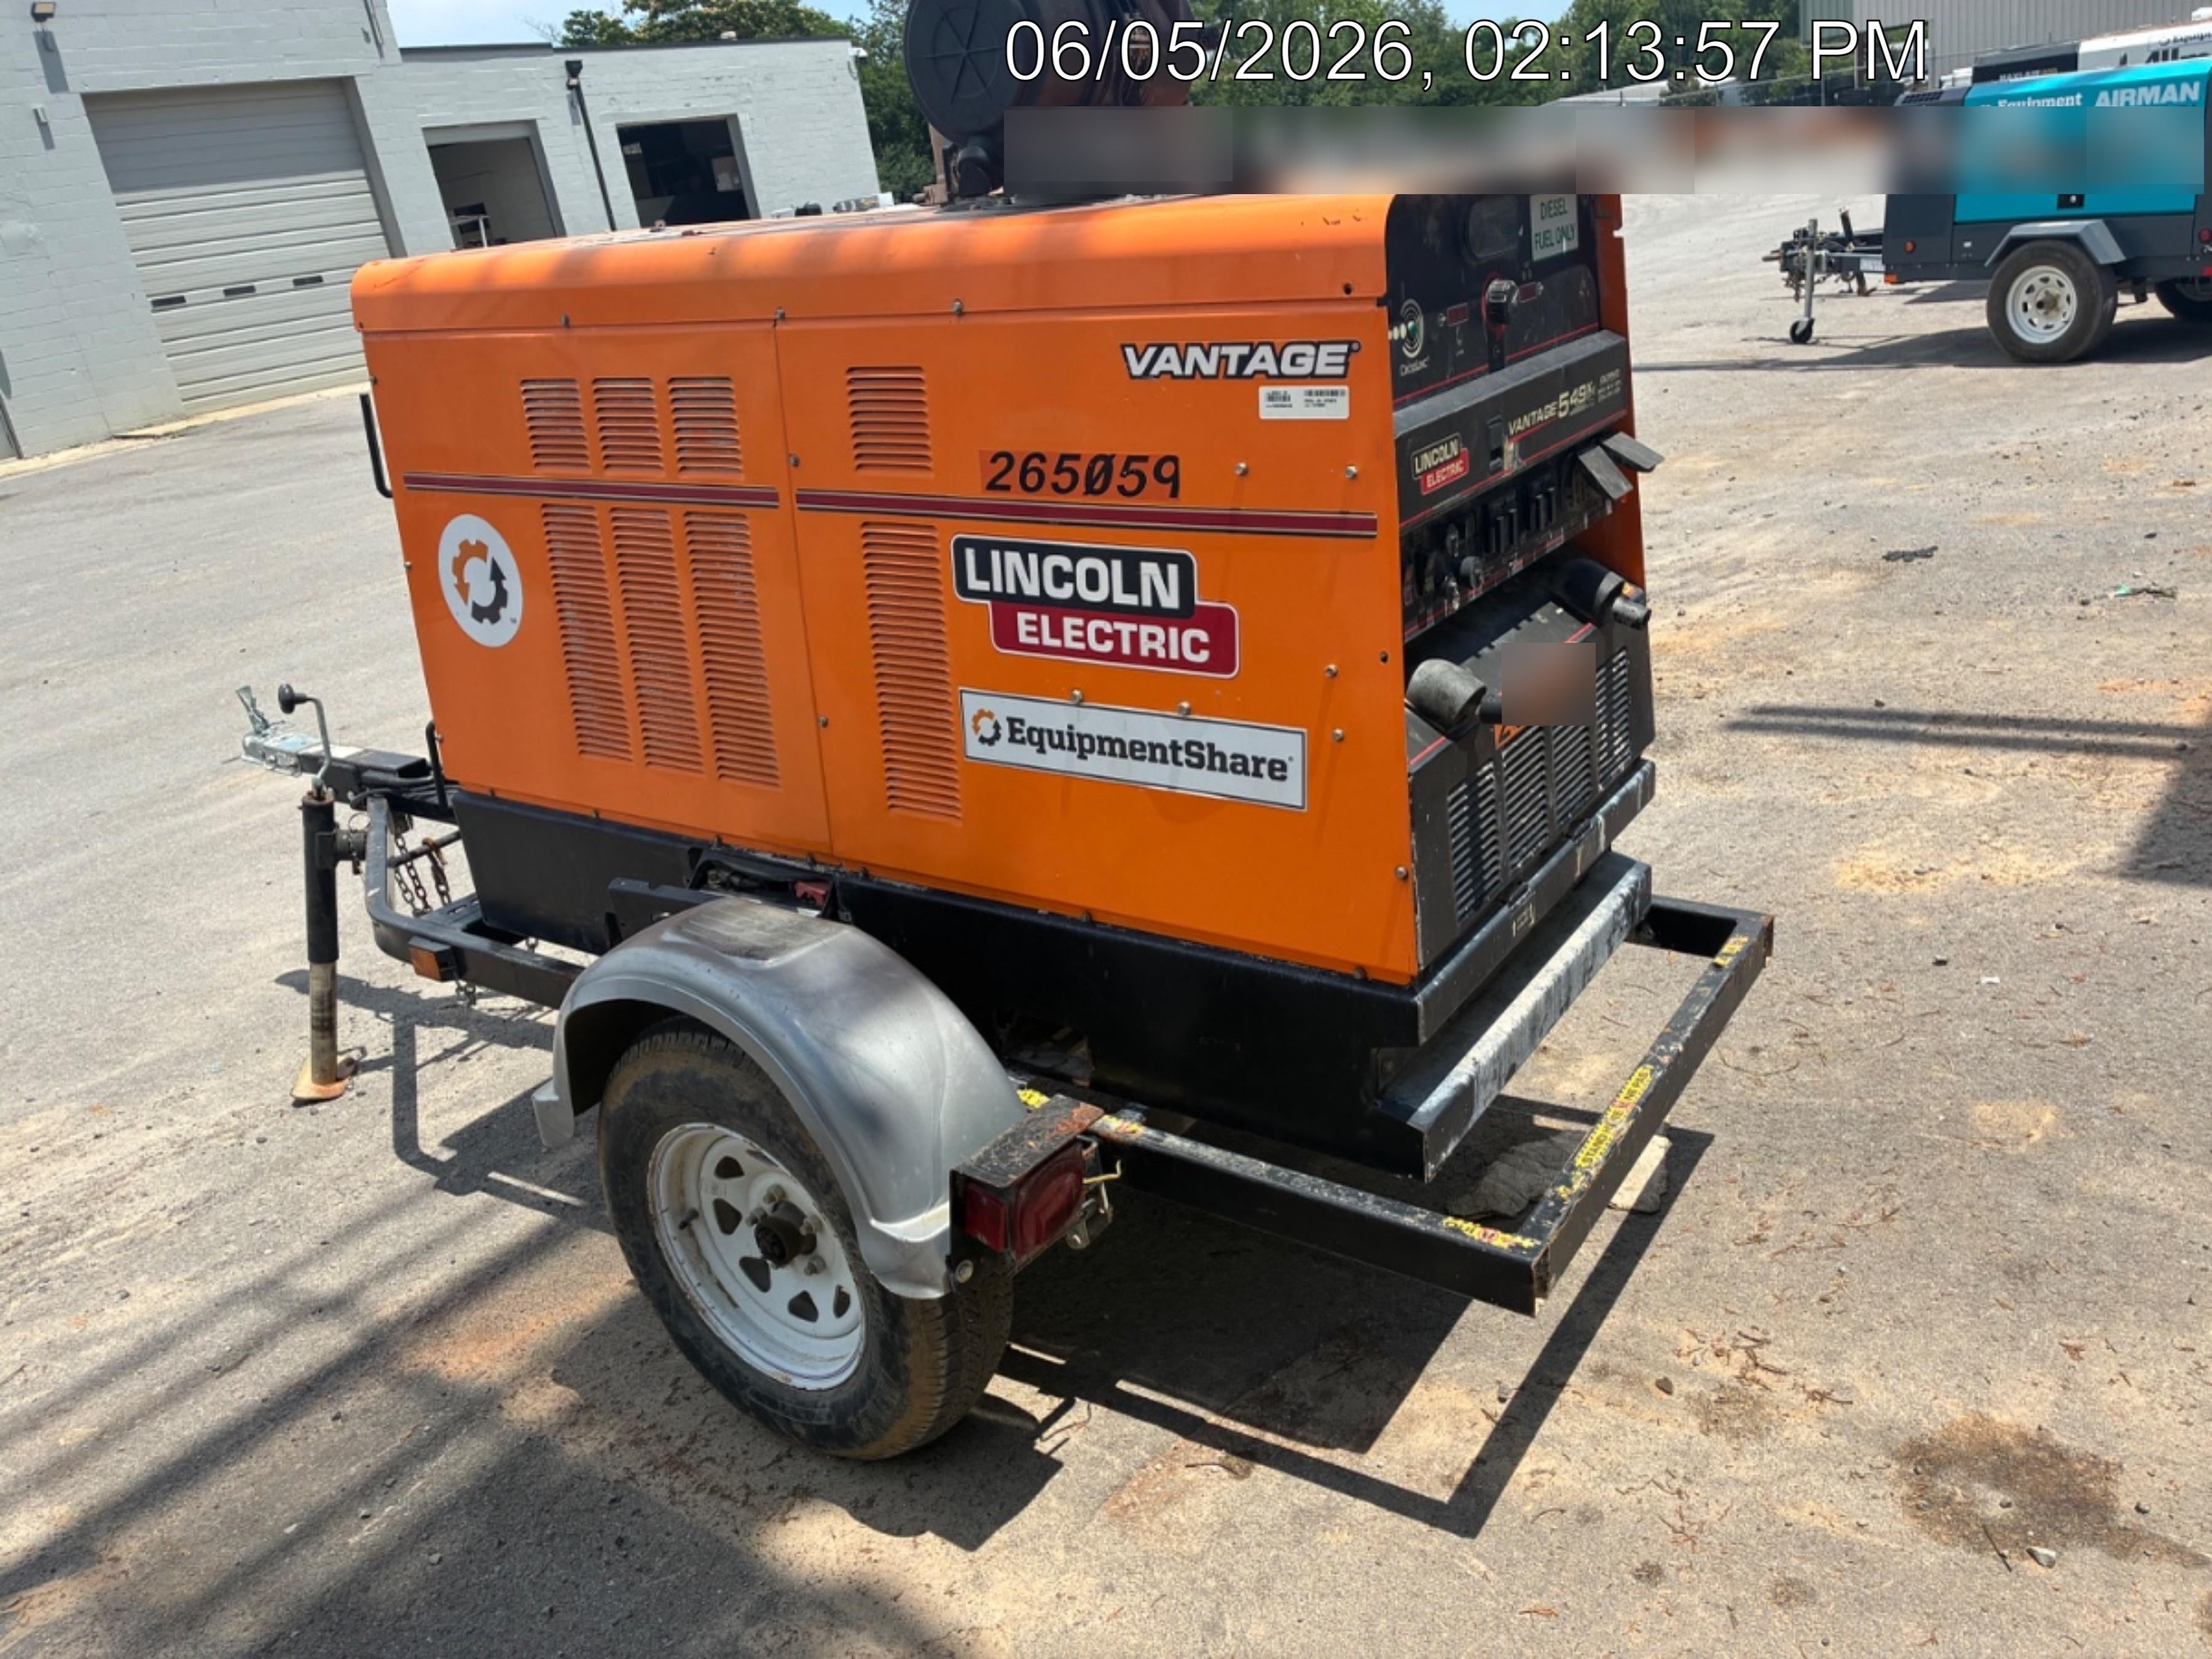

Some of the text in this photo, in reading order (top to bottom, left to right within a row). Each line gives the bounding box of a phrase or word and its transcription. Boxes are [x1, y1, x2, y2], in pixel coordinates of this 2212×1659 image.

[2096, 80, 2200, 106] AIRMAN
[1540, 197, 1567, 220] DIESEL
[1534, 229, 1555, 251] FUEL
[1122, 342, 1353, 378] VANTAGE
[1508, 401, 1558, 436] VANTAGE
[1415, 438, 1459, 474] LINCOLN
[1426, 460, 1465, 488] ELECTRIC
[964, 547, 1180, 610] LINCOLN
[1017, 612, 1210, 663] ELECTRIC
[1006, 717, 1288, 781] EquipmentShare
